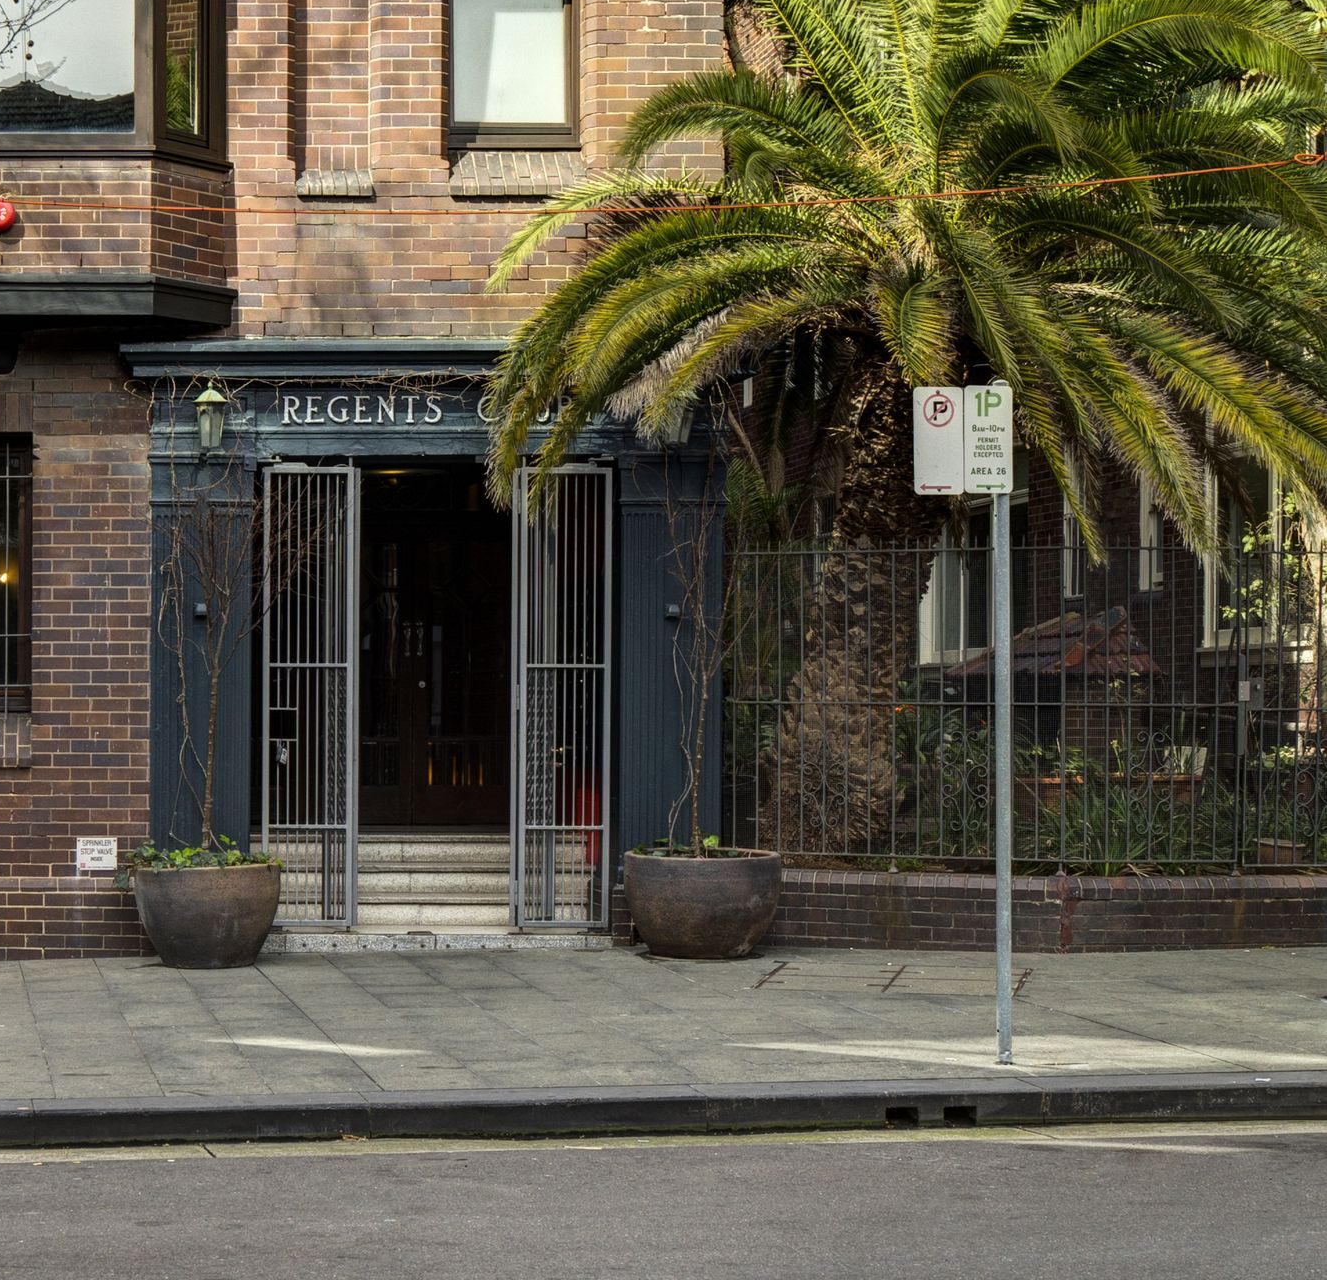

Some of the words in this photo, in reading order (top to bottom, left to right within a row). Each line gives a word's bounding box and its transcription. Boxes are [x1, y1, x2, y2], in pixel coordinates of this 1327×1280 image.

[281, 395, 441, 424] REGENTS
[975, 392, 1002, 417] 1P
[971, 467, 992, 475] AREA
[996, 467, 1006, 475] 26
